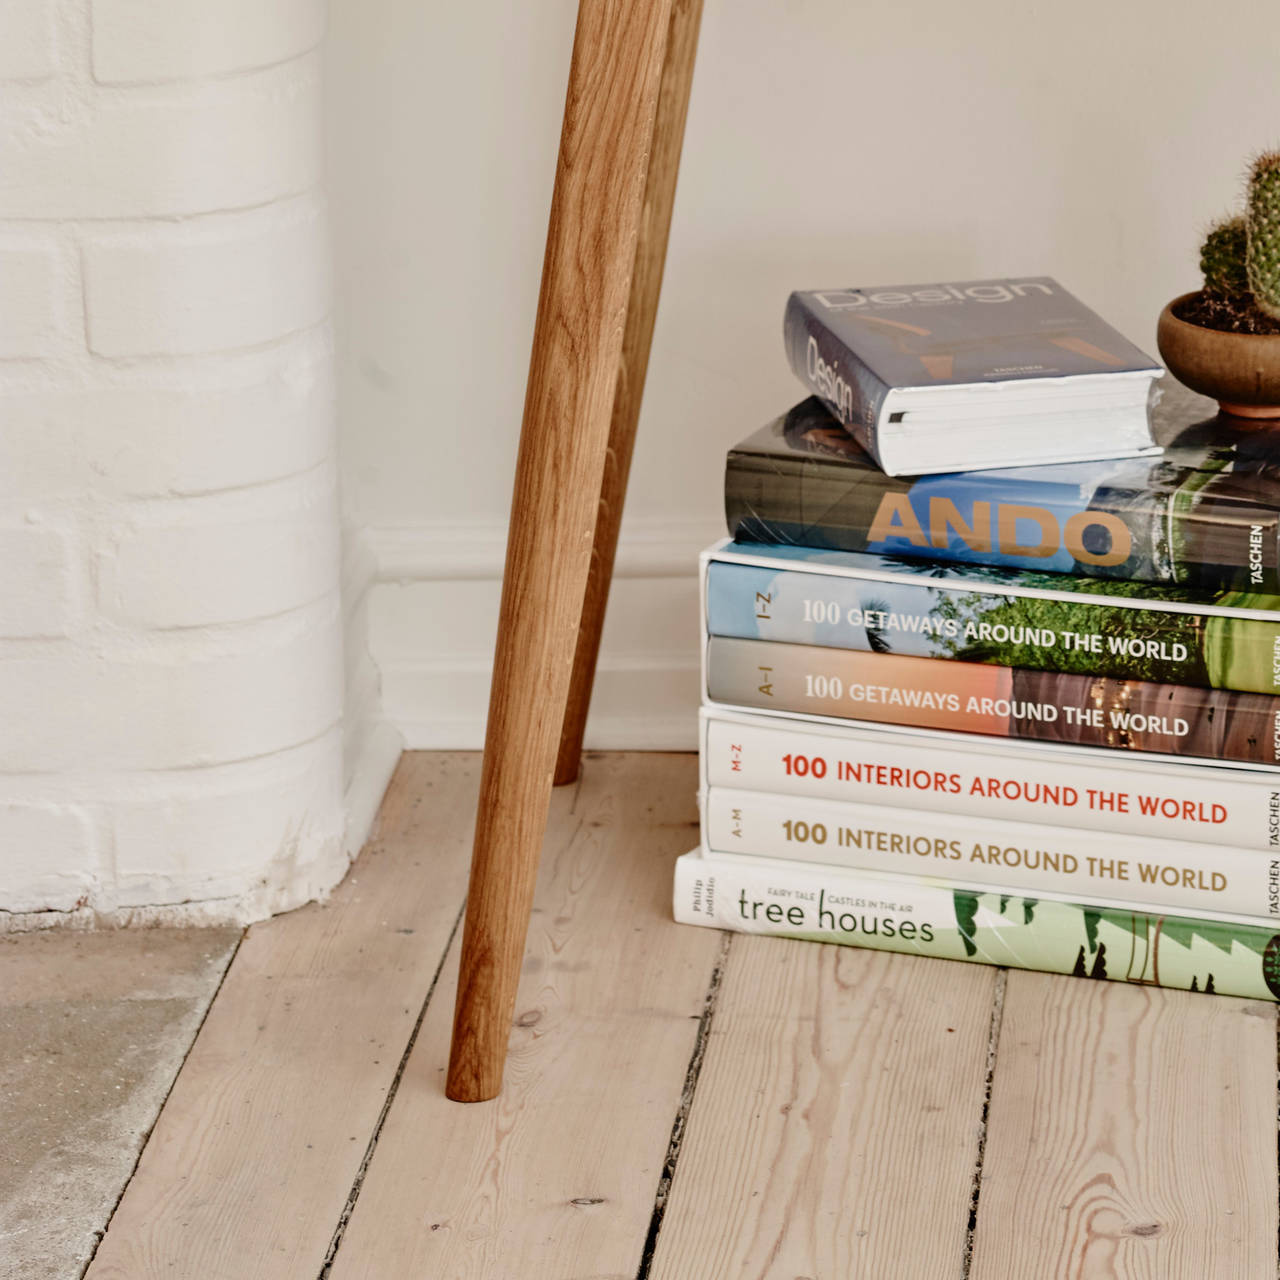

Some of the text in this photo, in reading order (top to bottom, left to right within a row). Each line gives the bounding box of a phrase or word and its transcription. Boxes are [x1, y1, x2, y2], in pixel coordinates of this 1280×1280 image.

[813, 282, 1053, 309] Design
[806, 335, 853, 424] Design
[866, 491, 1131, 567] ANDO
[1249, 524, 1264, 585] TASCHEN
[803, 599, 1188, 662] 100 GETAWAYS AROUND THE WORLD
[805, 675, 1190, 737] 100 GETAWAYS AROUND THE WORLD
[782, 753, 1228, 824] 100 INTERIORS AROUND THE WORLD
[1269, 792, 1280, 846] TASCHEN
[782, 819, 1228, 892] 100 INTERIORS AROUND THE WORLD
[692, 879, 703, 912] Philip
[738, 888, 935, 942] tree houses
[767, 887, 914, 913] FAIRY TALE CASTLES IN THE AIR
[1268, 860, 1280, 914] TASCHEN
